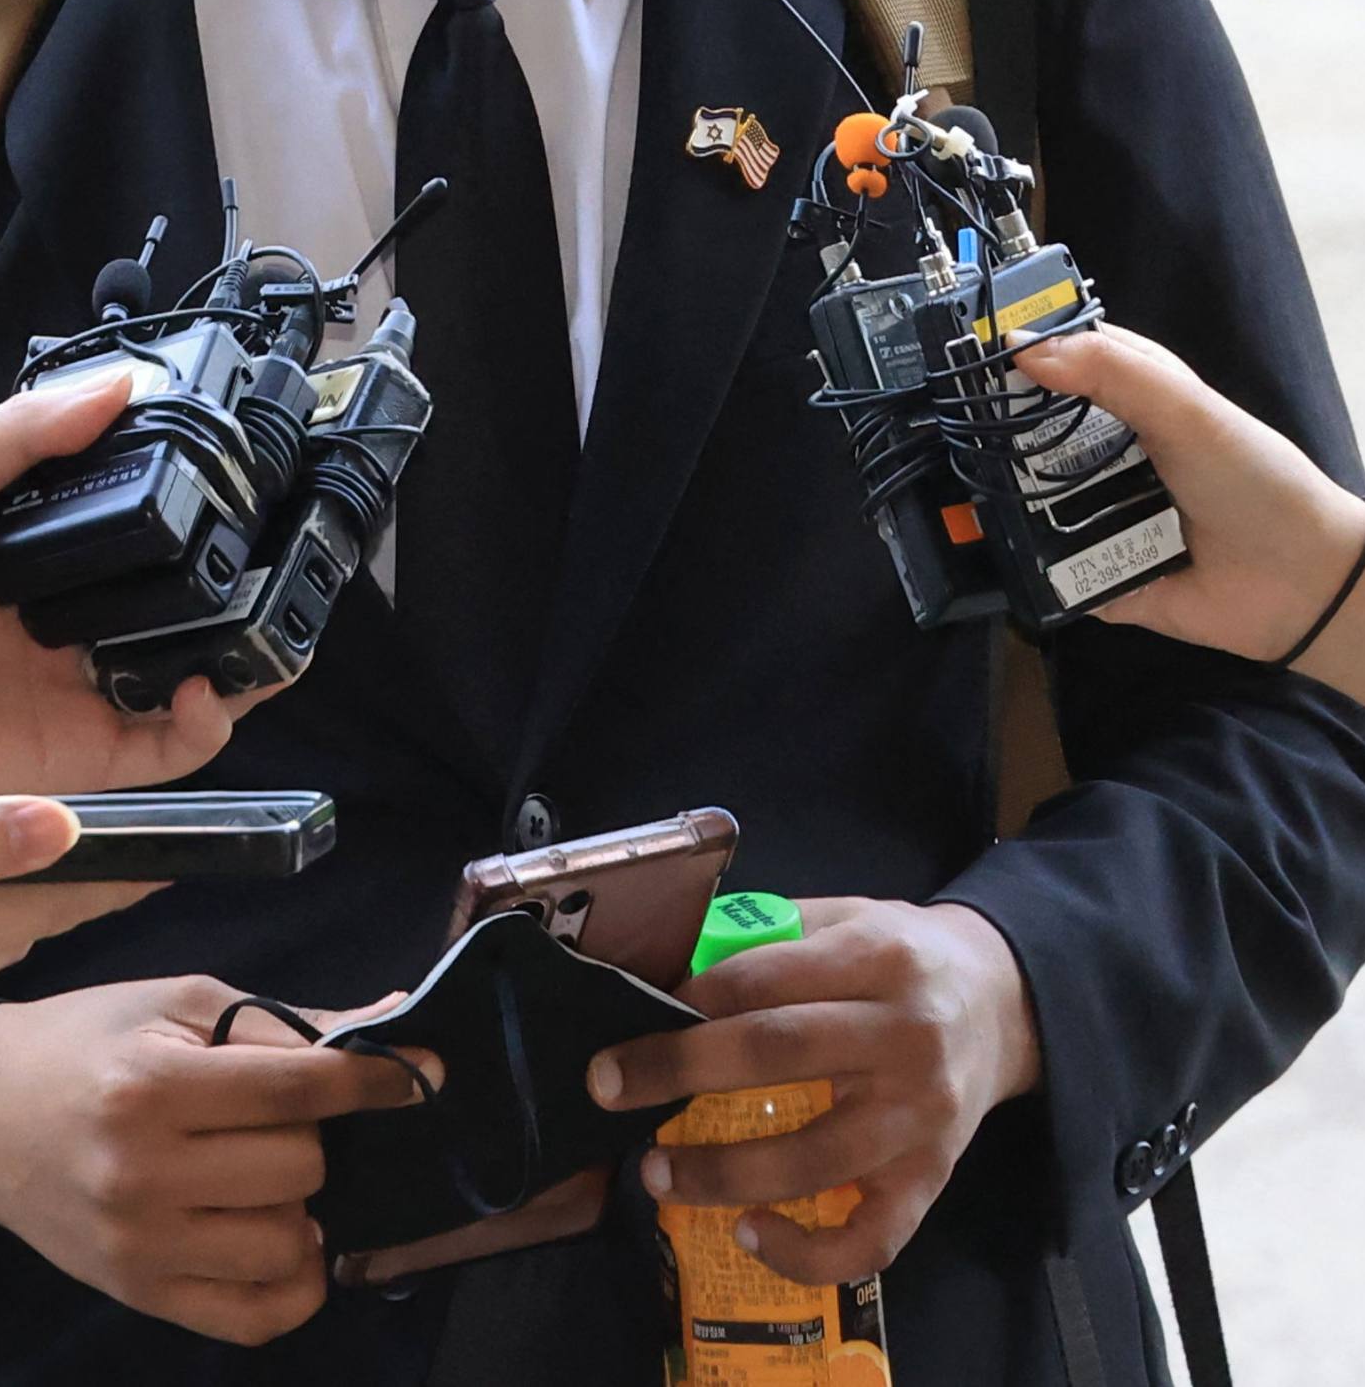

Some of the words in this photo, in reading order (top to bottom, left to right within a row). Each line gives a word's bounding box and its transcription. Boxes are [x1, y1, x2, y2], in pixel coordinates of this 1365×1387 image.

[1068, 558, 1097, 579] YTN
[716, 903, 758, 930] Maid
[731, 894, 776, 927] Minute
